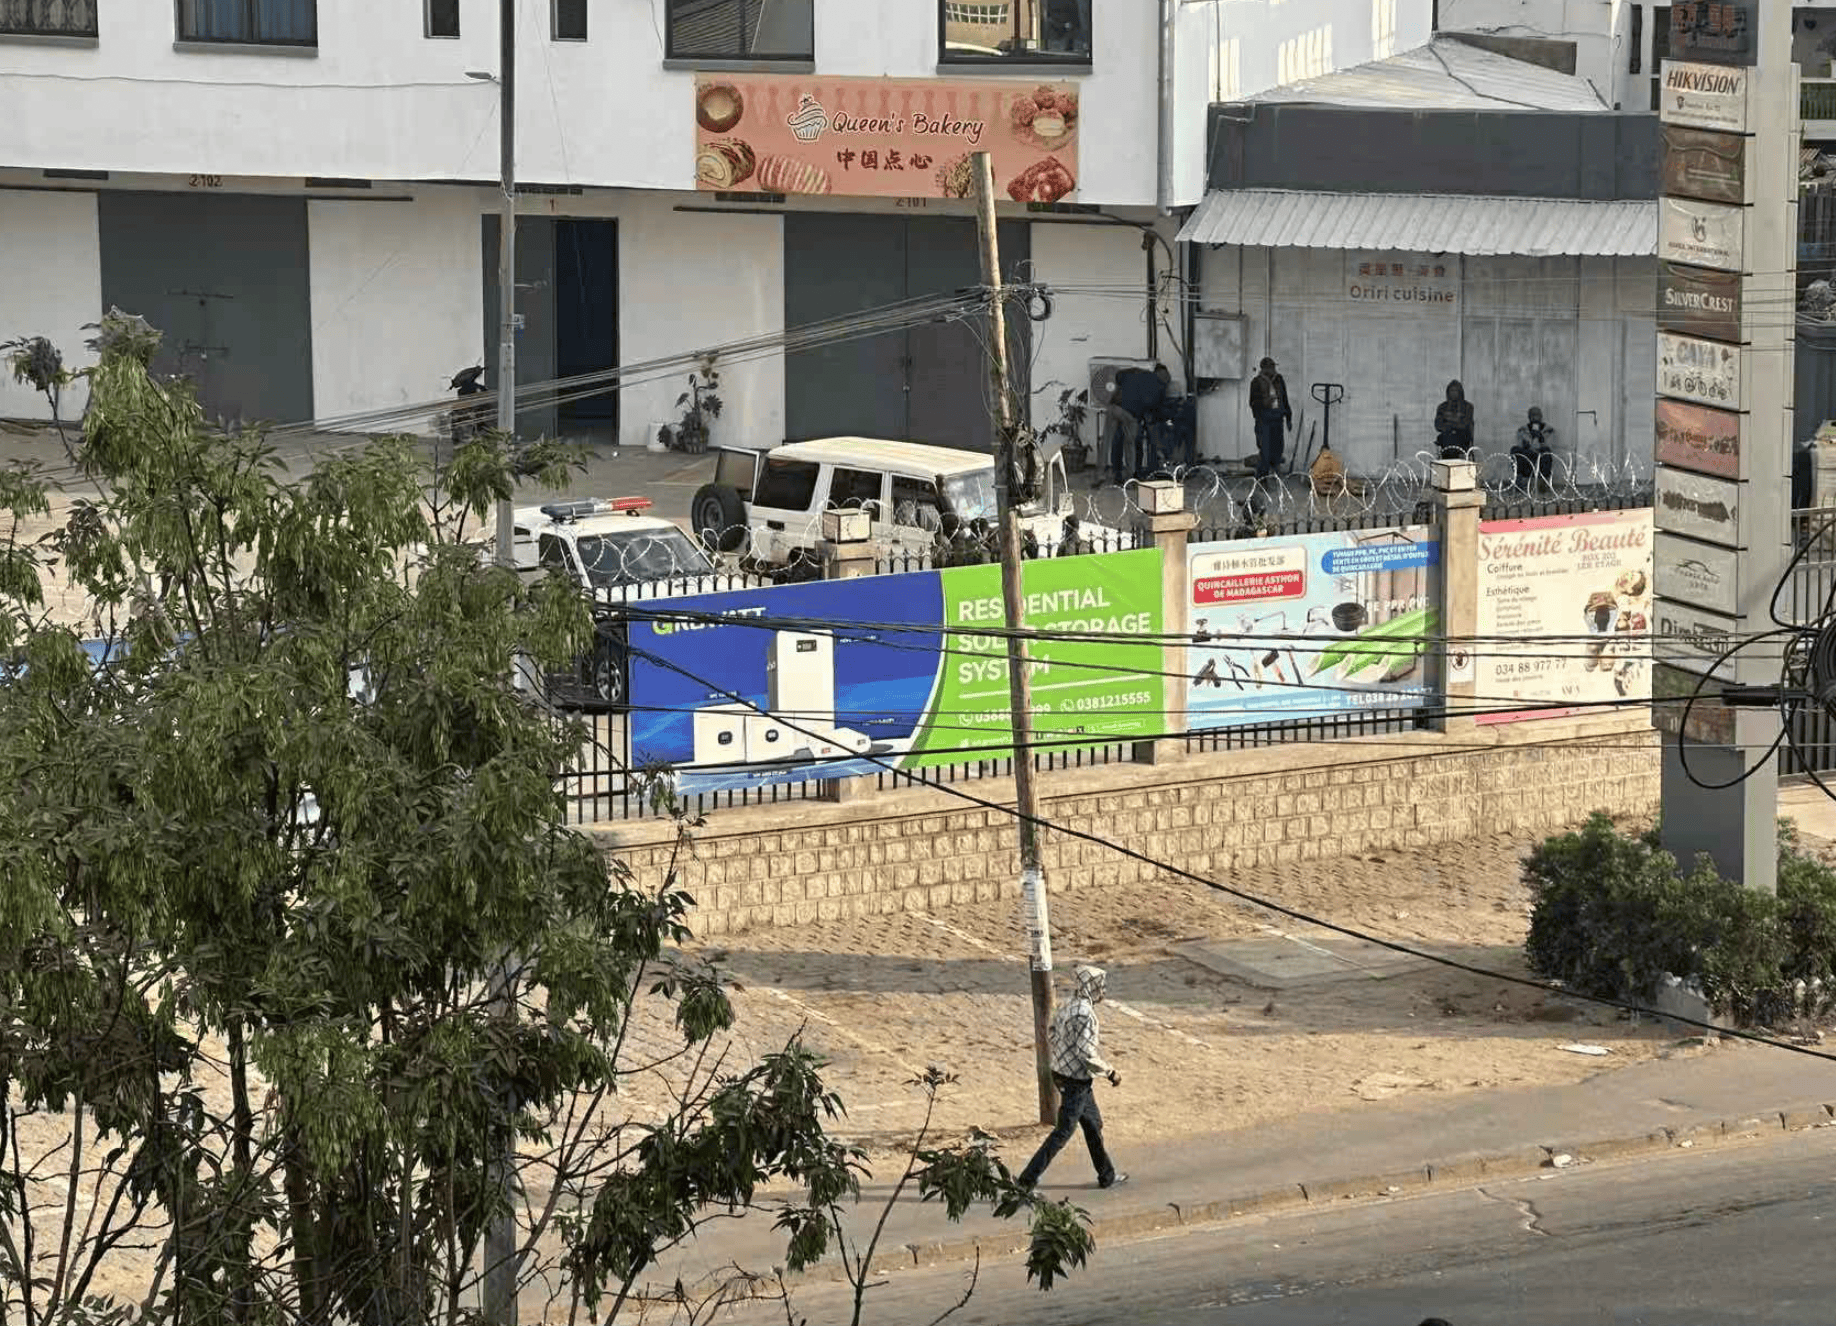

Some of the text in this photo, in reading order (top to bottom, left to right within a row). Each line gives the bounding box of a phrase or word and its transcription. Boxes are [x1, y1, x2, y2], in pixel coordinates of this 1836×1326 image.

[1666, 70, 1741, 94] HIKVISION
[832, 111, 984, 144] Queen's Bakery
[836, 148, 933, 171] 中国点心
[1350, 285, 1454, 302] Oriri cuisine
[1477, 524, 1648, 561] Sérénité Beauté
[1487, 562, 1523, 574] Coiffure
[1213, 584, 1284, 599] DE MADAGASCAR
[1486, 585, 1530, 597] Esthétique
[958, 587, 1111, 622] RESENTIAL
[958, 654, 1050, 684] SYSTM
[1496, 663, 1514, 676] 034
[1518, 662, 1531, 673] 88
